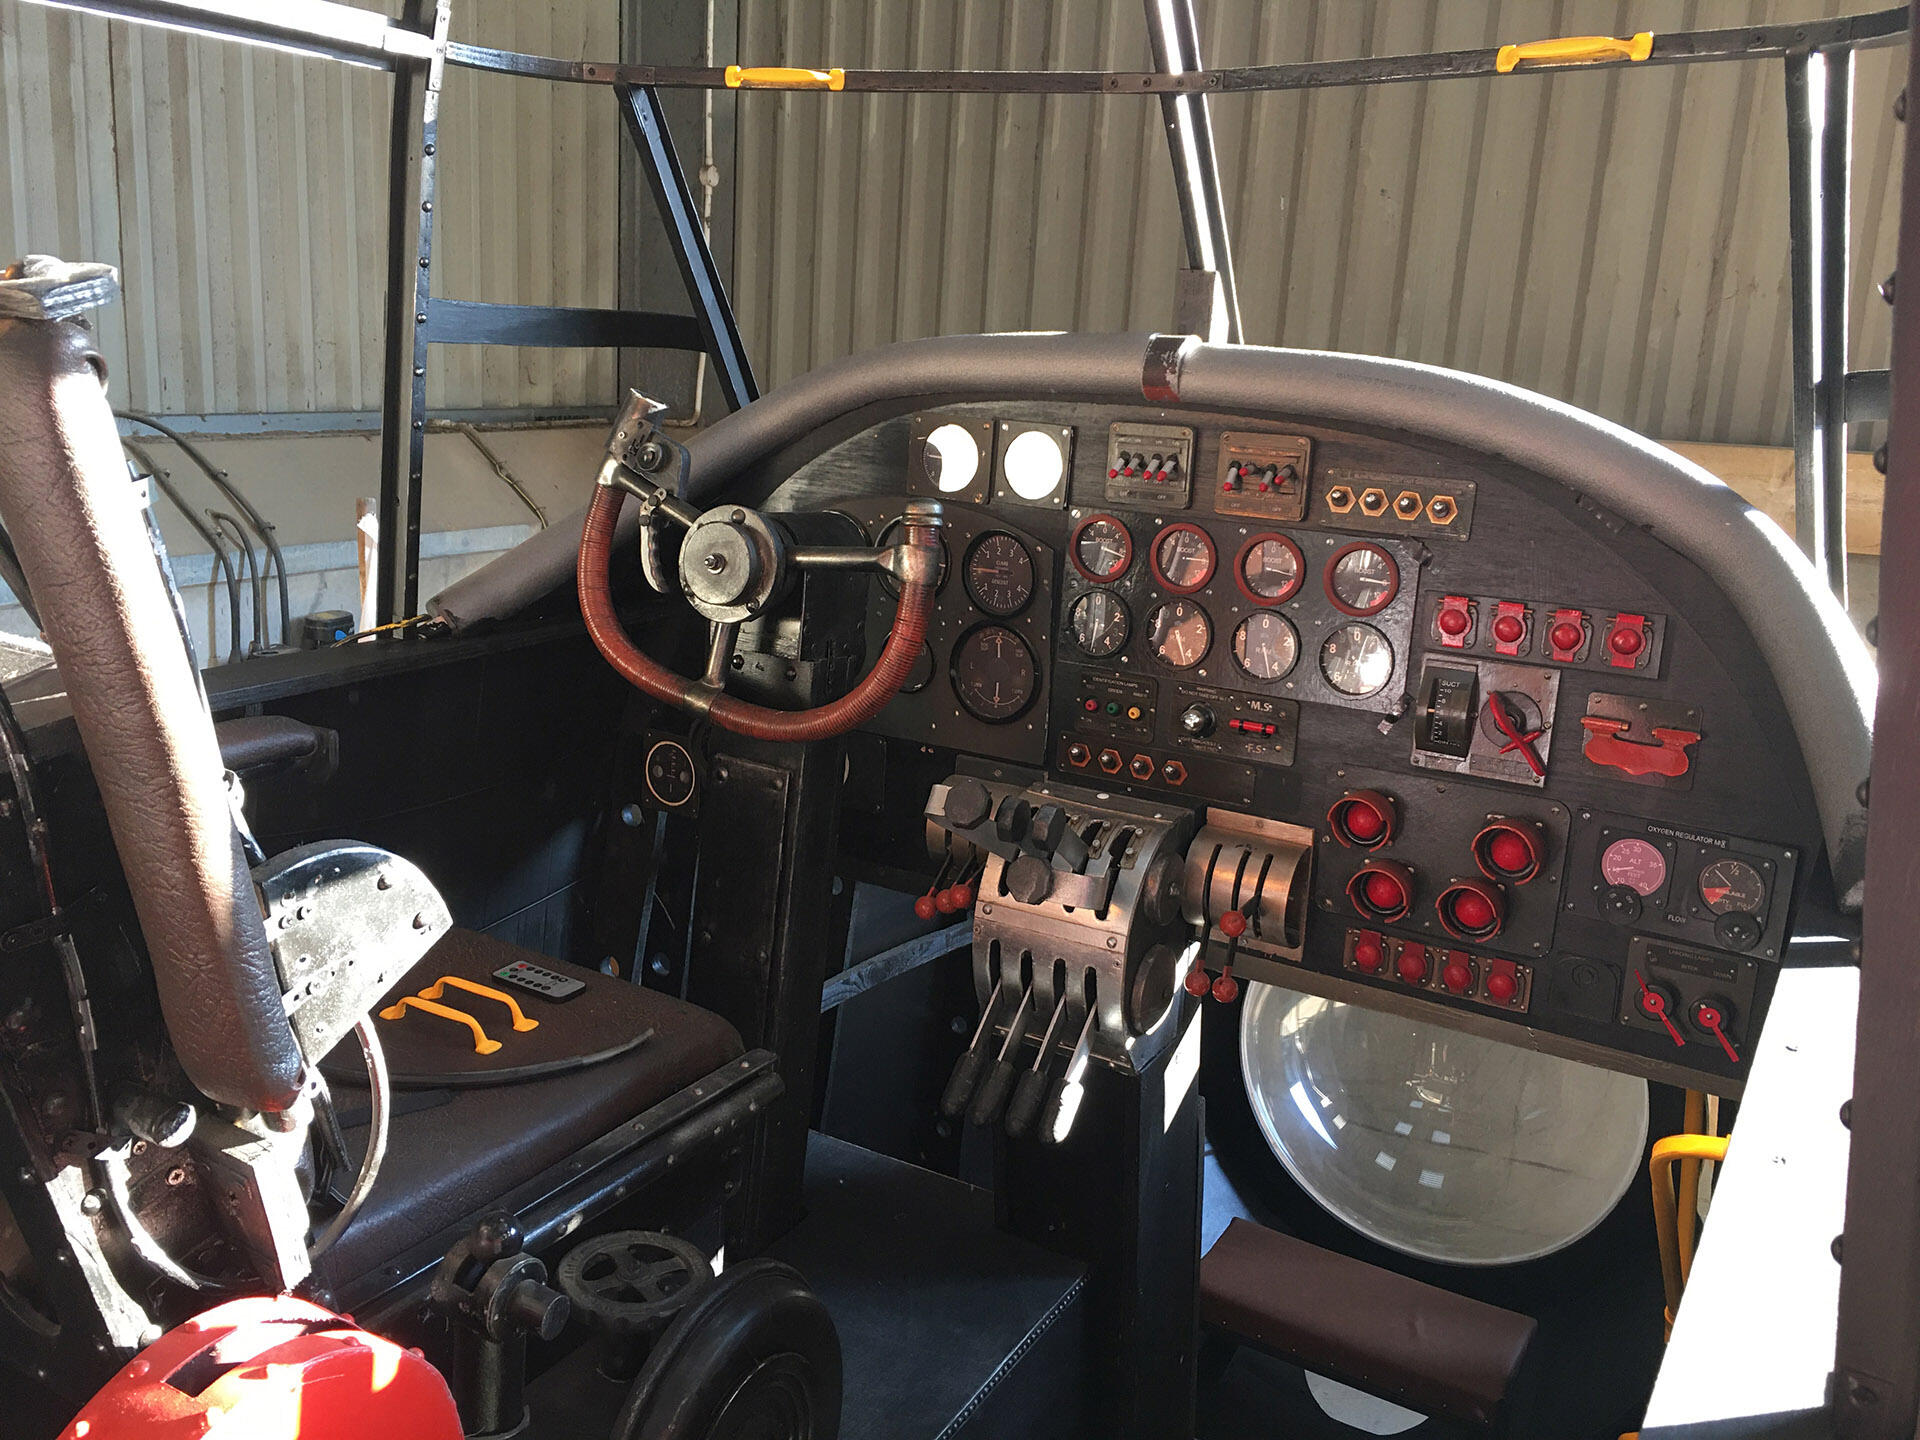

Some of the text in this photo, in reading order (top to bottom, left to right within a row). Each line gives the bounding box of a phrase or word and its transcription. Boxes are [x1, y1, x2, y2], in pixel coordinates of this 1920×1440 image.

[996, 547, 1002, 556] 2
[1009, 549, 1014, 558] 3
[994, 589, 998, 597] 2
[1007, 590, 1012, 598] 3
[1096, 596, 1102, 605] 0
[1075, 608, 1081, 616] 8
[1176, 606, 1182, 616] 0
[1114, 612, 1120, 622] 2
[1262, 619, 1270, 628] 0
[1196, 624, 1202, 634] 2
[1079, 633, 1086, 642] 6
[1240, 631, 1246, 640] 8
[1354, 631, 1360, 640] 0
[1104, 636, 1110, 646] 4
[1283, 636, 1290, 646] 2
[1160, 646, 1166, 654] 6
[1185, 649, 1192, 658] 4
[1330, 644, 1336, 654] 8
[1244, 658, 1250, 668] 6
[1272, 662, 1278, 671] 4
[1334, 672, 1340, 681] 6
[1442, 680, 1460, 688] SUCT
[1648, 824, 1674, 836] OXYGEN
[1675, 830, 1713, 844] REGULATOR
[1668, 914, 1686, 923] FLOW
